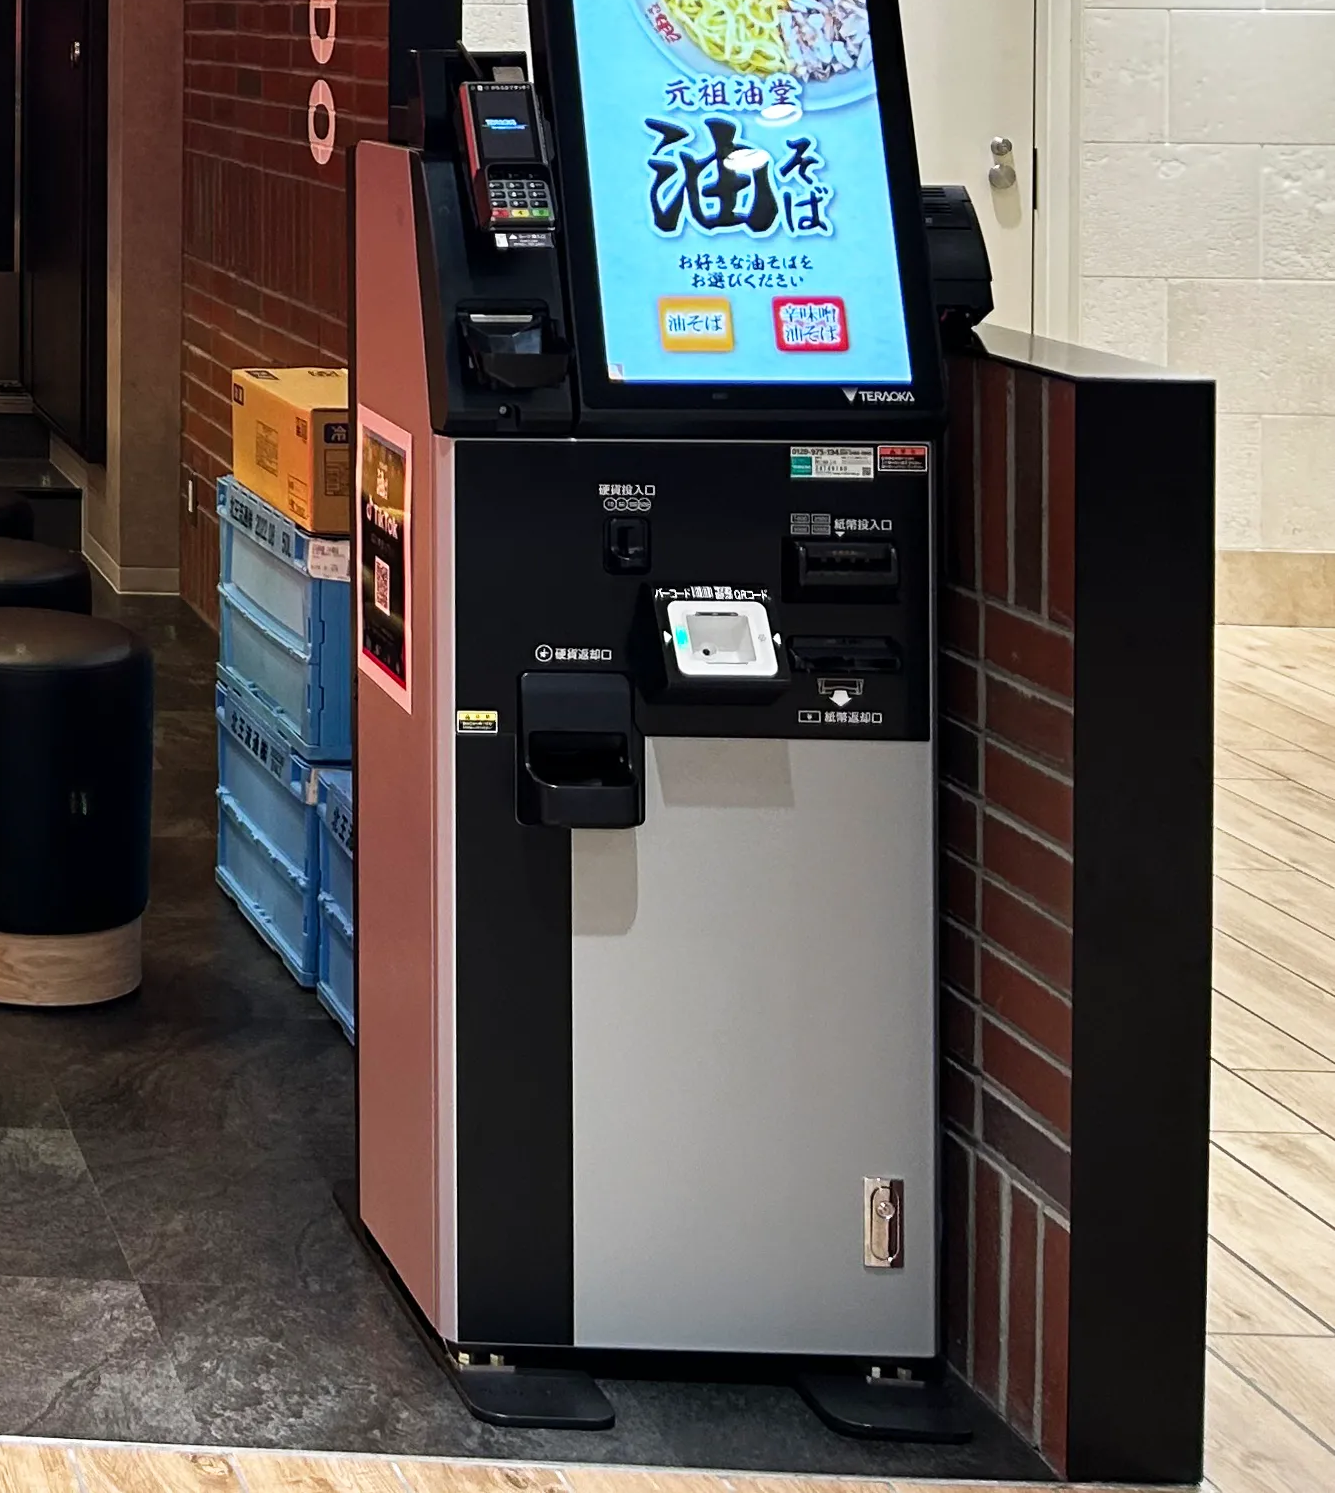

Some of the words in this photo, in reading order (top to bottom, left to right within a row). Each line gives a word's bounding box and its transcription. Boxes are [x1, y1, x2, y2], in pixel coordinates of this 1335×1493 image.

[664, 78, 797, 106] 元祖油堂
[678, 253, 814, 272] お好きな油そばを
[691, 271, 804, 289] お選びください
[668, 313, 724, 332] 油そば
[858, 390, 916, 402] TERAOKA
[833, 518, 893, 532] 紙幣投入口
